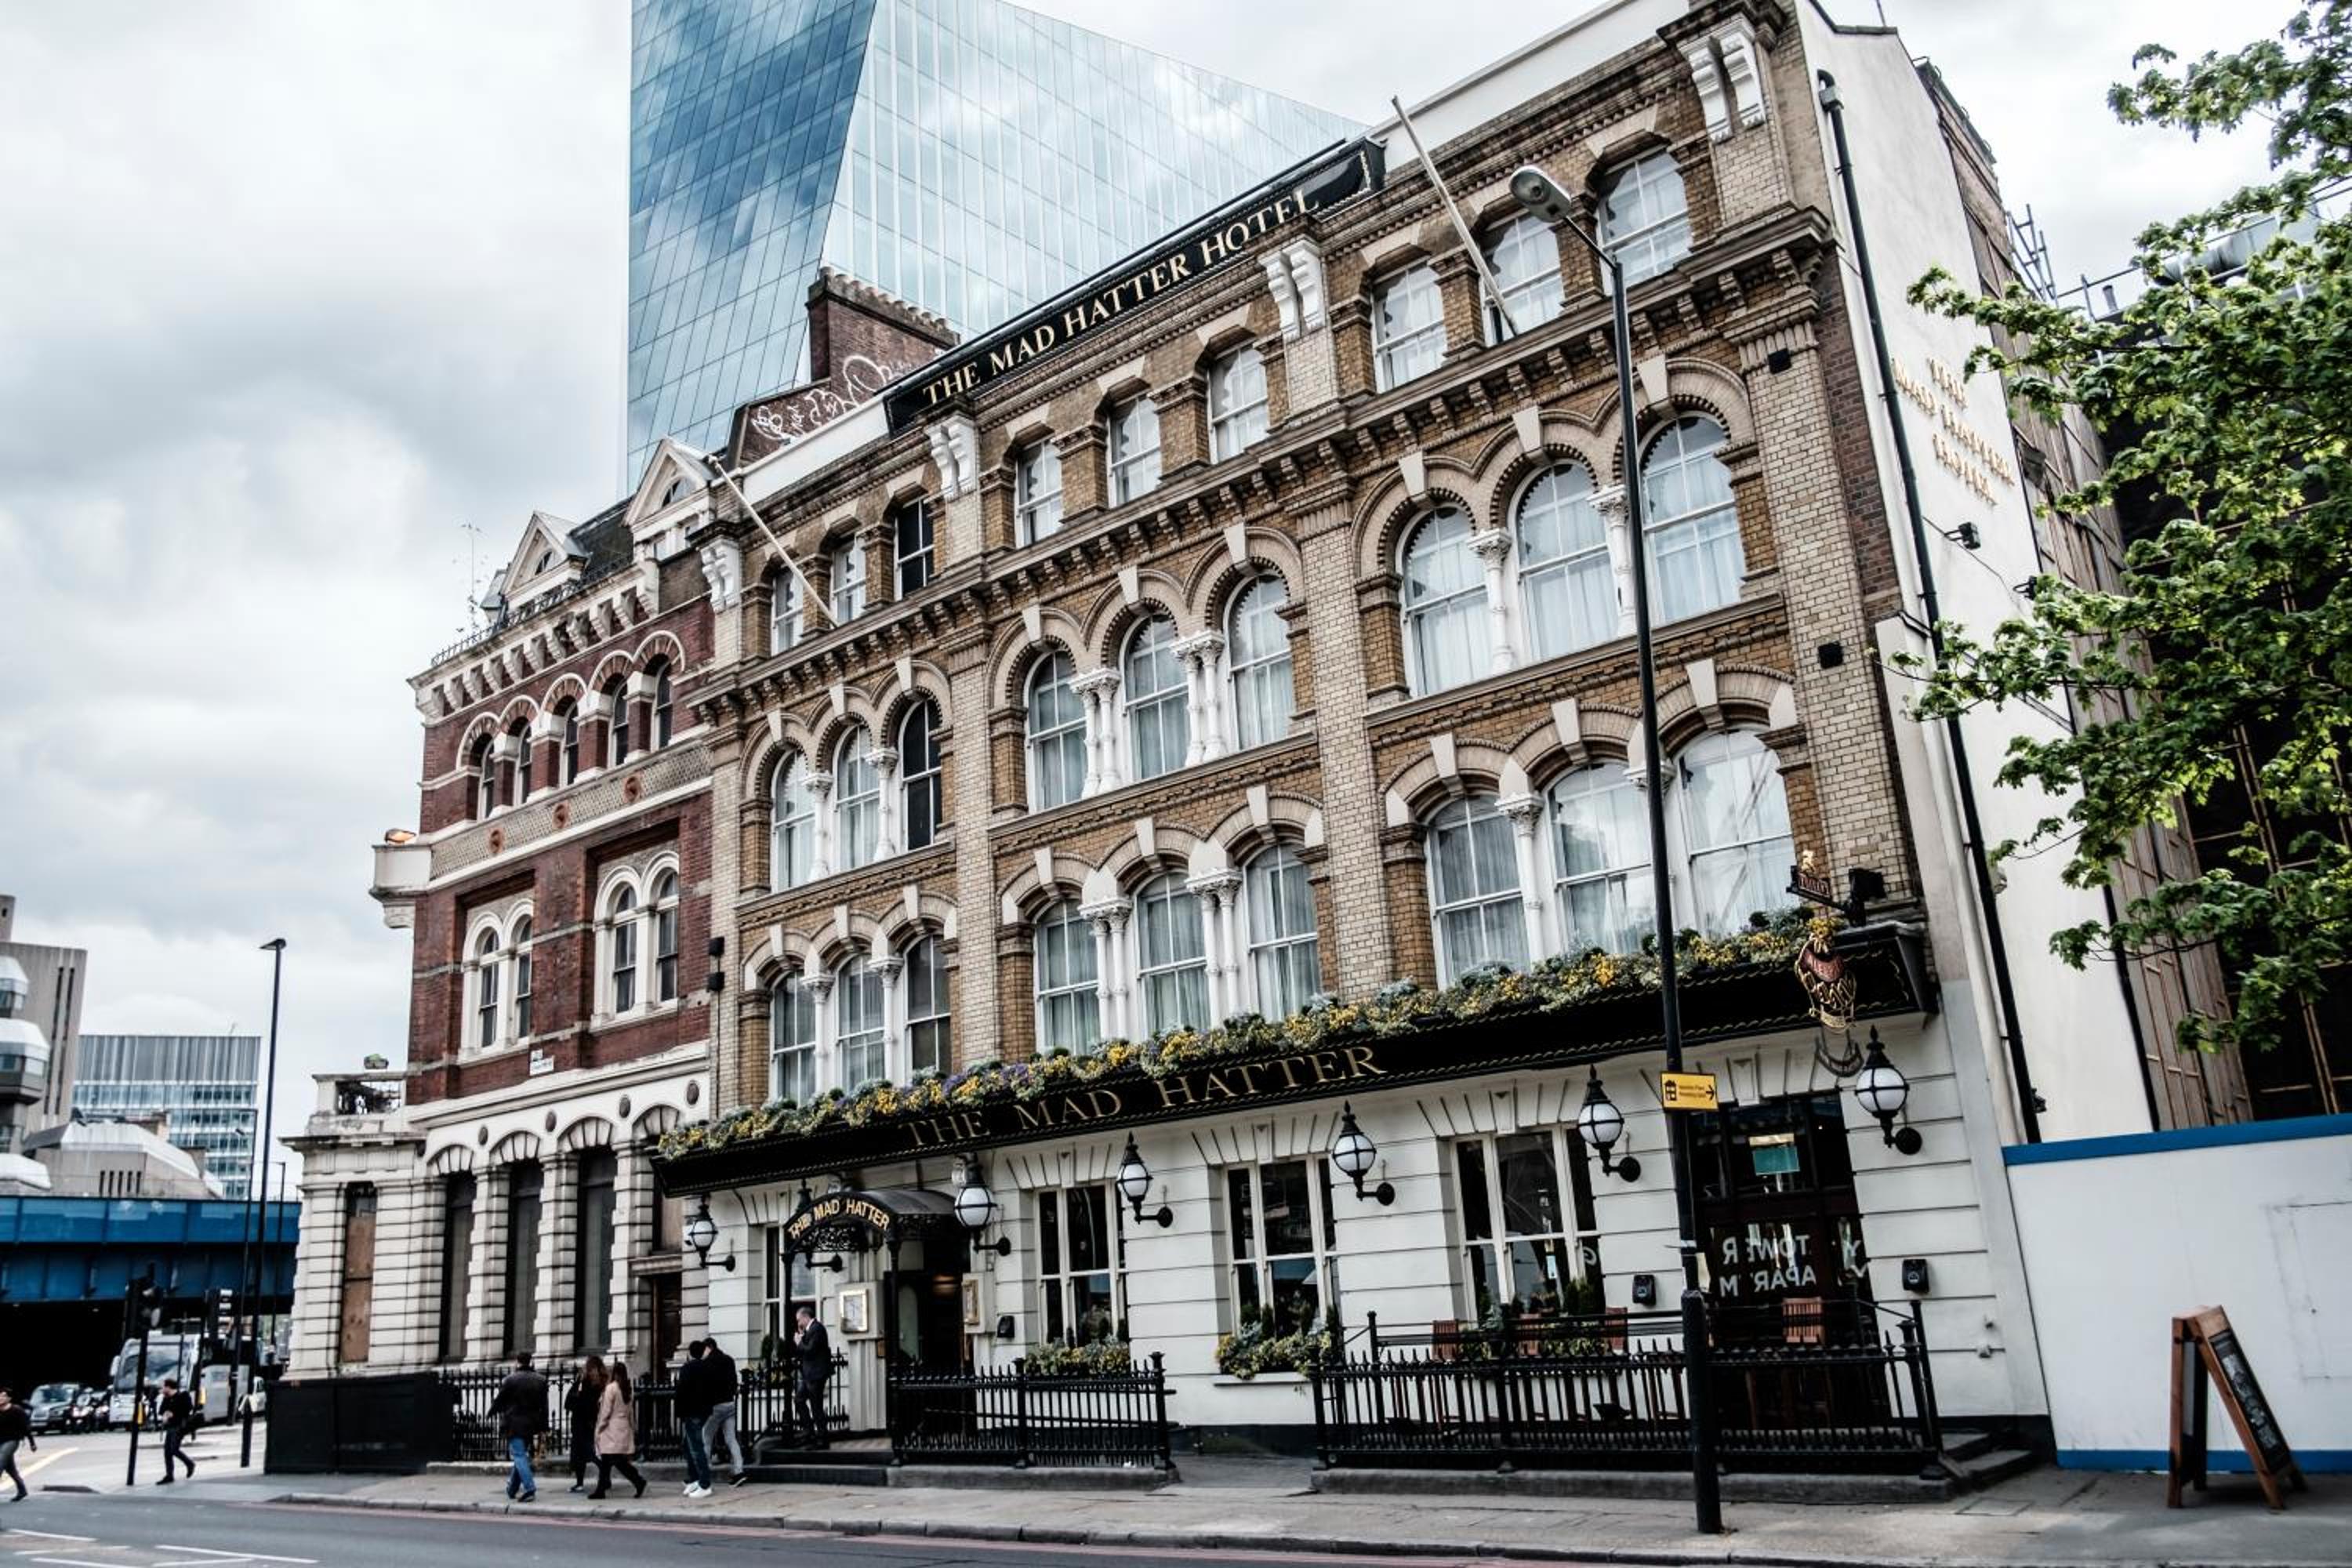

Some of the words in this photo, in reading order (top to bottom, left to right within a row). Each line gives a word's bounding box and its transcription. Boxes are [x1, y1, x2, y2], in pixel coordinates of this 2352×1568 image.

[923, 361, 981, 405] THE
[990, 325, 1055, 376] MAD
[1063, 254, 1192, 336] HATTER
[1200, 189, 1319, 267] HOTEL
[899, 1111, 991, 1147] THE
[1013, 1090, 1122, 1130] MAD
[1156, 1046, 1387, 1107] HATTER
[788, 1214, 812, 1239] THE
[814, 1200, 840, 1221] MAD
[846, 1199, 890, 1230] HATTER
